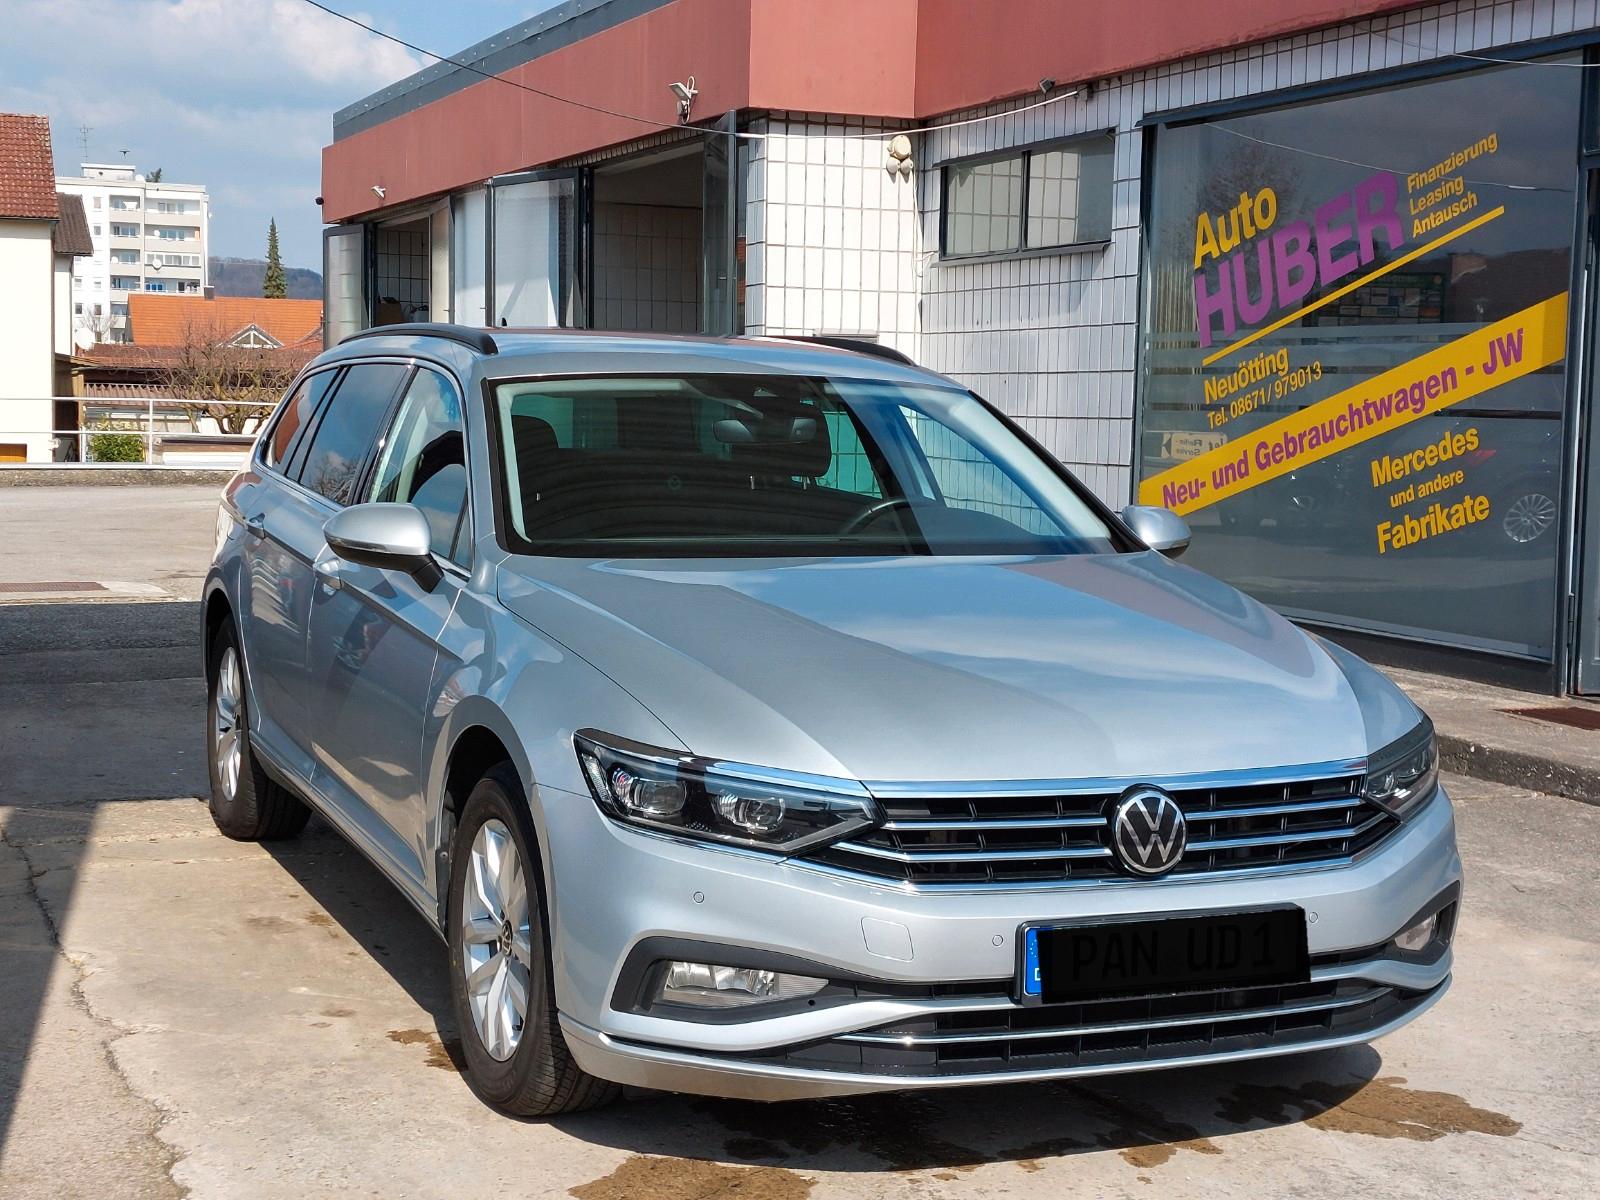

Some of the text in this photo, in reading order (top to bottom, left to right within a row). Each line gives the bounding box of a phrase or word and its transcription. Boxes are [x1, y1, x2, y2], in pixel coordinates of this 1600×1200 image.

[1407, 132, 1498, 194] Finanzierung
[1409, 175, 1464, 216] Leasing
[1412, 190, 1478, 239] Antausch
[1193, 187, 1277, 270] Auto
[1194, 171, 1405, 348] HUBER
[1203, 347, 1289, 405] Neuötting
[1162, 477, 1207, 509] Neu-
[1212, 449, 1250, 490] und
[1255, 366, 1458, 471] Gebrauchtwagen
[1482, 327, 1524, 375] JW
[1207, 407, 1229, 430] Tel.
[1370, 427, 1480, 488] Mercedes
[1390, 469, 1464, 508] und andere
[1376, 495, 1490, 554] Fabrikate
[1117, 792, 1185, 872] VW
[1072, 929, 1158, 981] PAN
